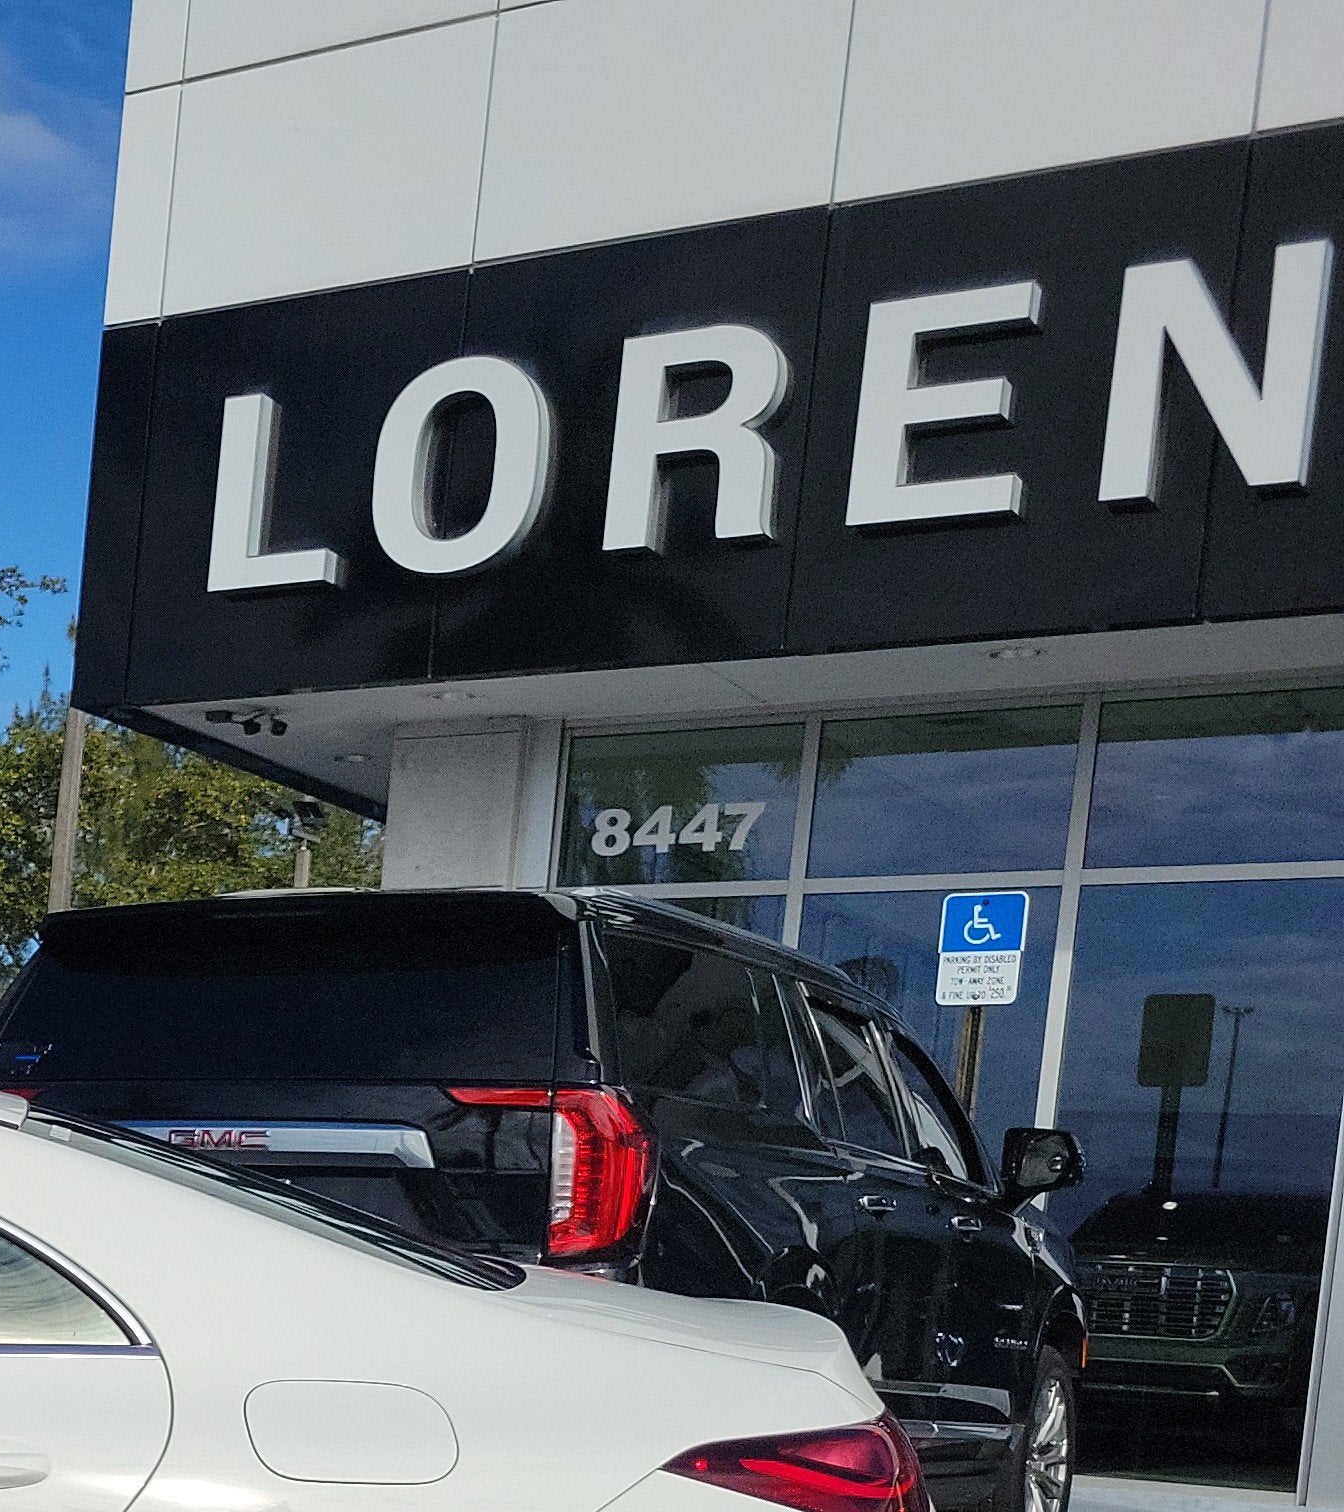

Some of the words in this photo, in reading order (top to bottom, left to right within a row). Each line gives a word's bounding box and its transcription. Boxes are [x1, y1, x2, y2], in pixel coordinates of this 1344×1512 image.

[206, 237, 1334, 593] LOREN
[591, 802, 767, 857] 8447
[943, 956, 970, 964] PARKING
[984, 955, 1016, 963] DISABLED
[168, 1128, 269, 1149] GMC
